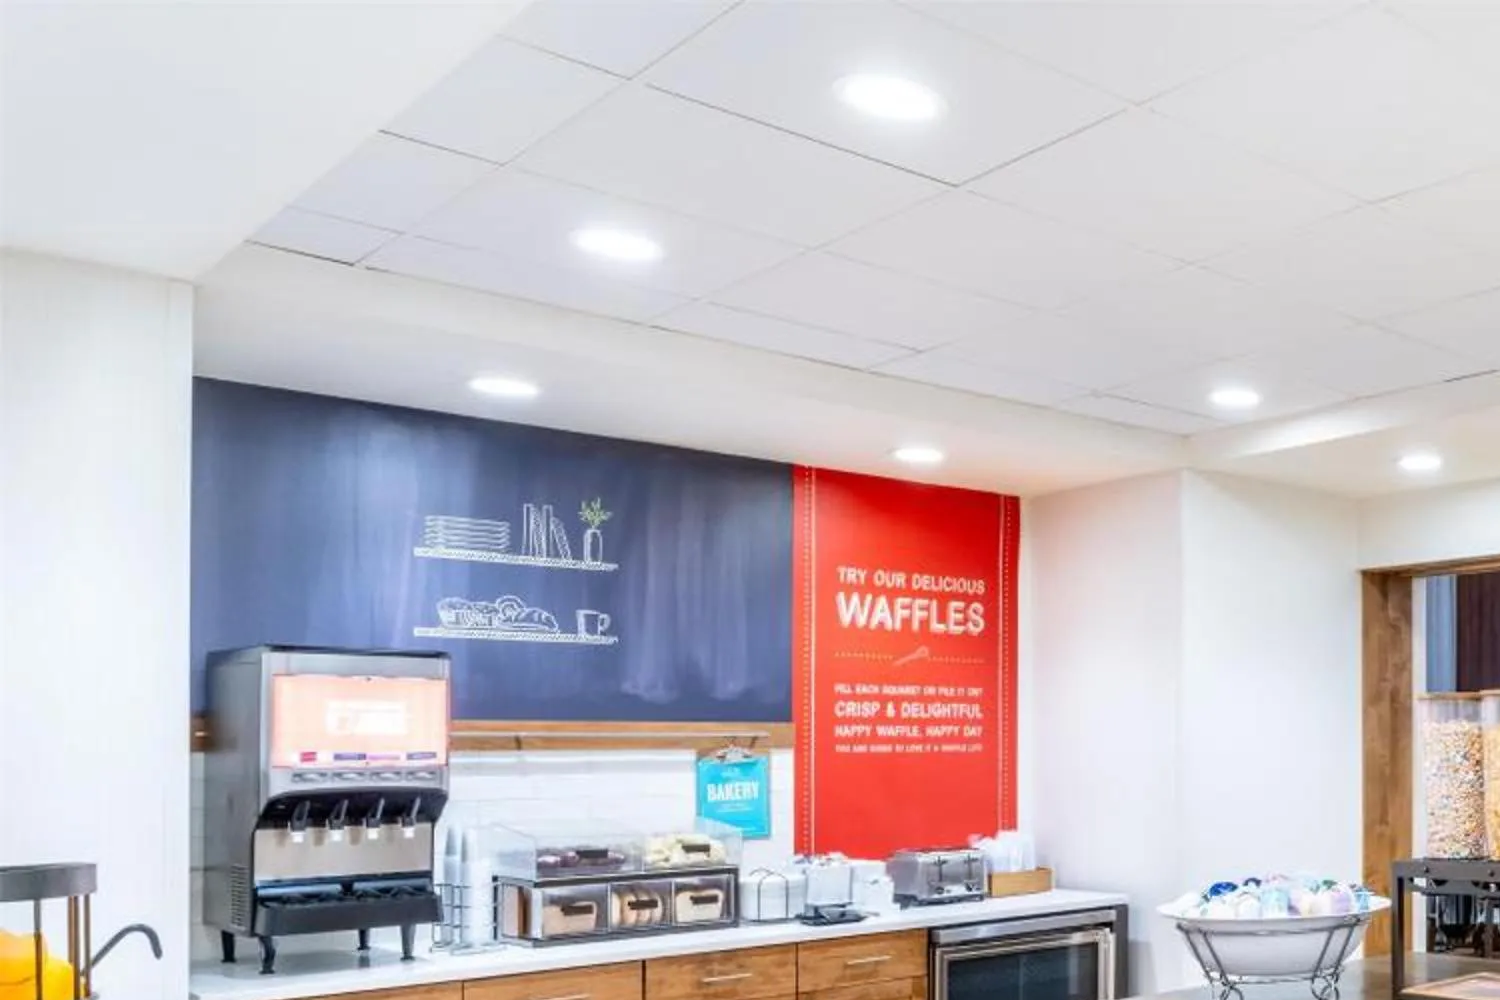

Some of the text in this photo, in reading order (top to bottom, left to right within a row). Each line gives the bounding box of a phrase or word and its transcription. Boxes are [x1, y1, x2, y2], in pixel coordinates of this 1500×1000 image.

[837, 566, 986, 596] TRY OUR DELICIOUS
[835, 591, 986, 636] WAFFLES
[833, 700, 881, 719] CRISP
[901, 701, 984, 720] DELIGHTFUL
[834, 723, 872, 738] HAPPY
[926, 724, 960, 738] HAPPY
[963, 725, 983, 738] DAY
[707, 780, 759, 803] BAKERY
